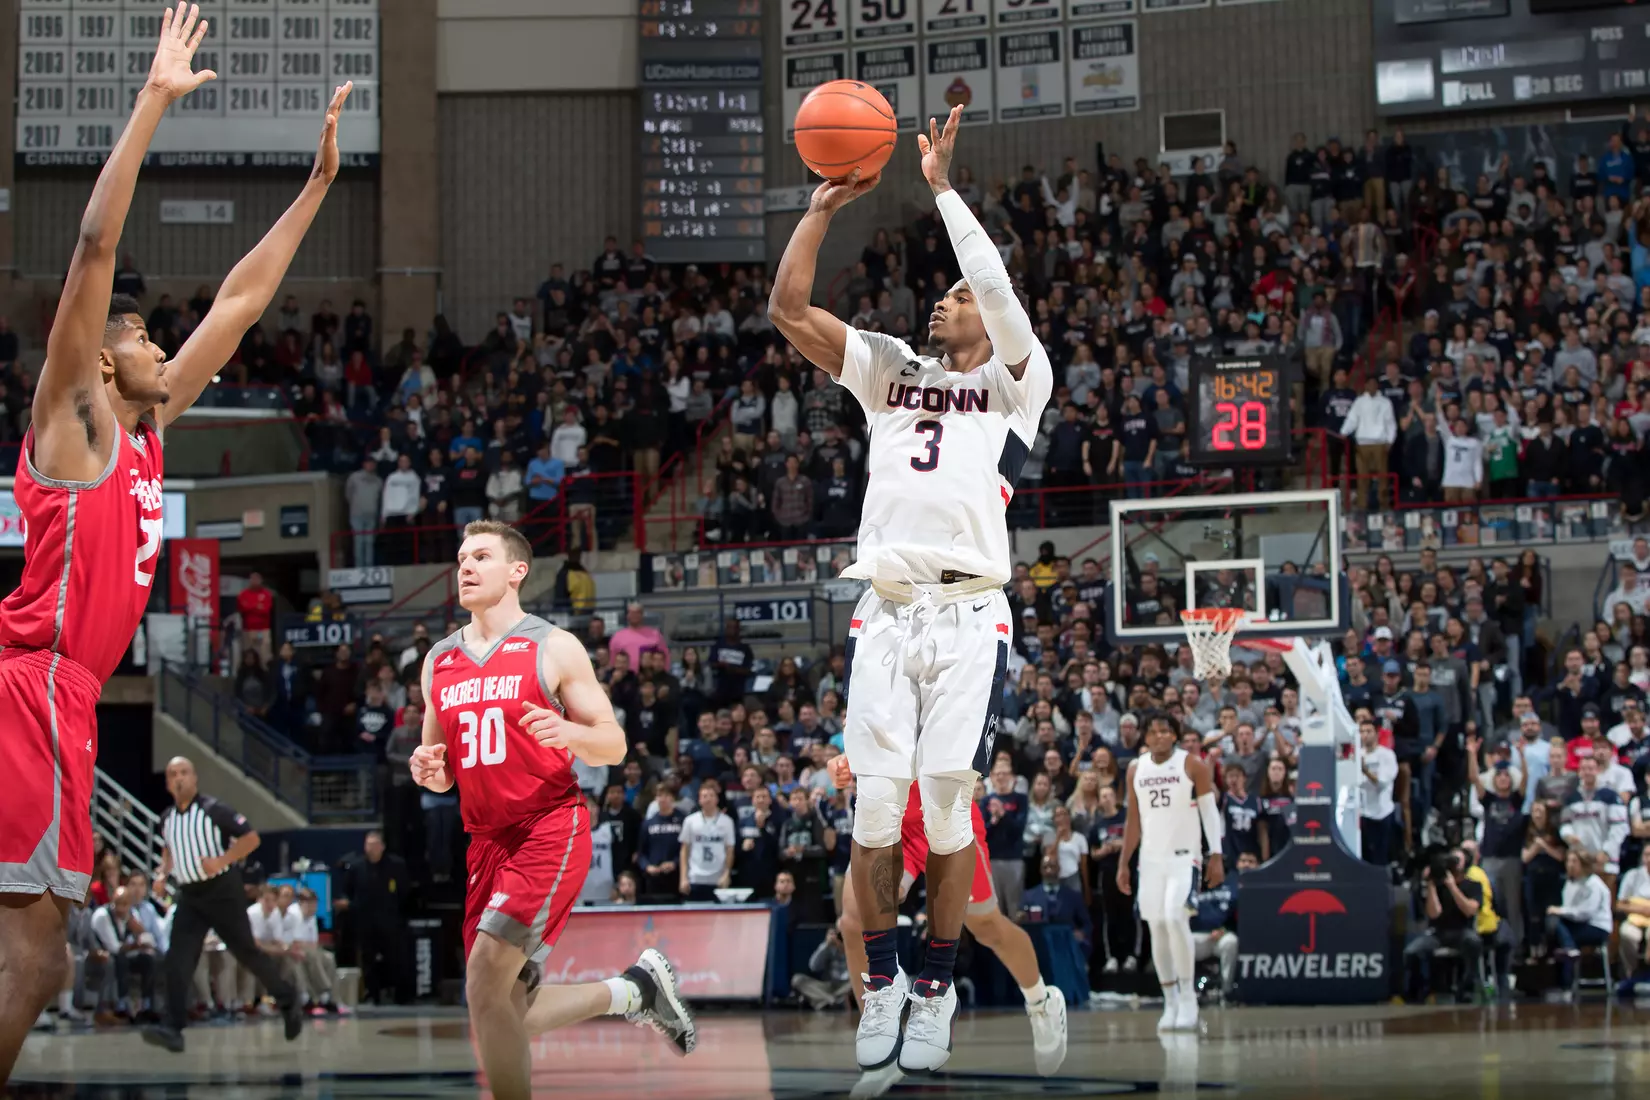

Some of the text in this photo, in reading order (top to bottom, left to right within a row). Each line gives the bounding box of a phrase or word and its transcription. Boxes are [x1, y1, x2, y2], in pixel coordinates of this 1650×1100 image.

[792, 0, 837, 30] 24
[231, 16, 270, 39] 2000
[284, 16, 320, 40] 2001
[333, 17, 373, 40] 2002
[25, 51, 64, 74] 2003
[76, 51, 115, 74] 2004
[230, 52, 269, 75] 2007
[282, 52, 321, 75] 2008
[333, 52, 373, 76] 2009
[25, 87, 64, 110] 2010
[77, 87, 115, 110] 2011
[230, 87, 269, 111] 2014
[282, 87, 319, 111] 2015
[1461, 82, 1496, 101] FULL
[24, 125, 61, 148] 2017
[1215, 369, 1274, 400] 16:42
[886, 381, 989, 414] UCONN
[1211, 401, 1267, 450] 28
[910, 419, 944, 472] 3
[735, 601, 809, 621] SEC 101
[285, 623, 353, 643] SEC 101
[502, 641, 531, 653] NEC
[440, 675, 523, 712] SACRED HEART
[458, 707, 507, 770] 30
[1139, 775, 1181, 788] UCONN
[1149, 788, 1171, 808] 25
[1239, 953, 1384, 978] TRAVELERS
